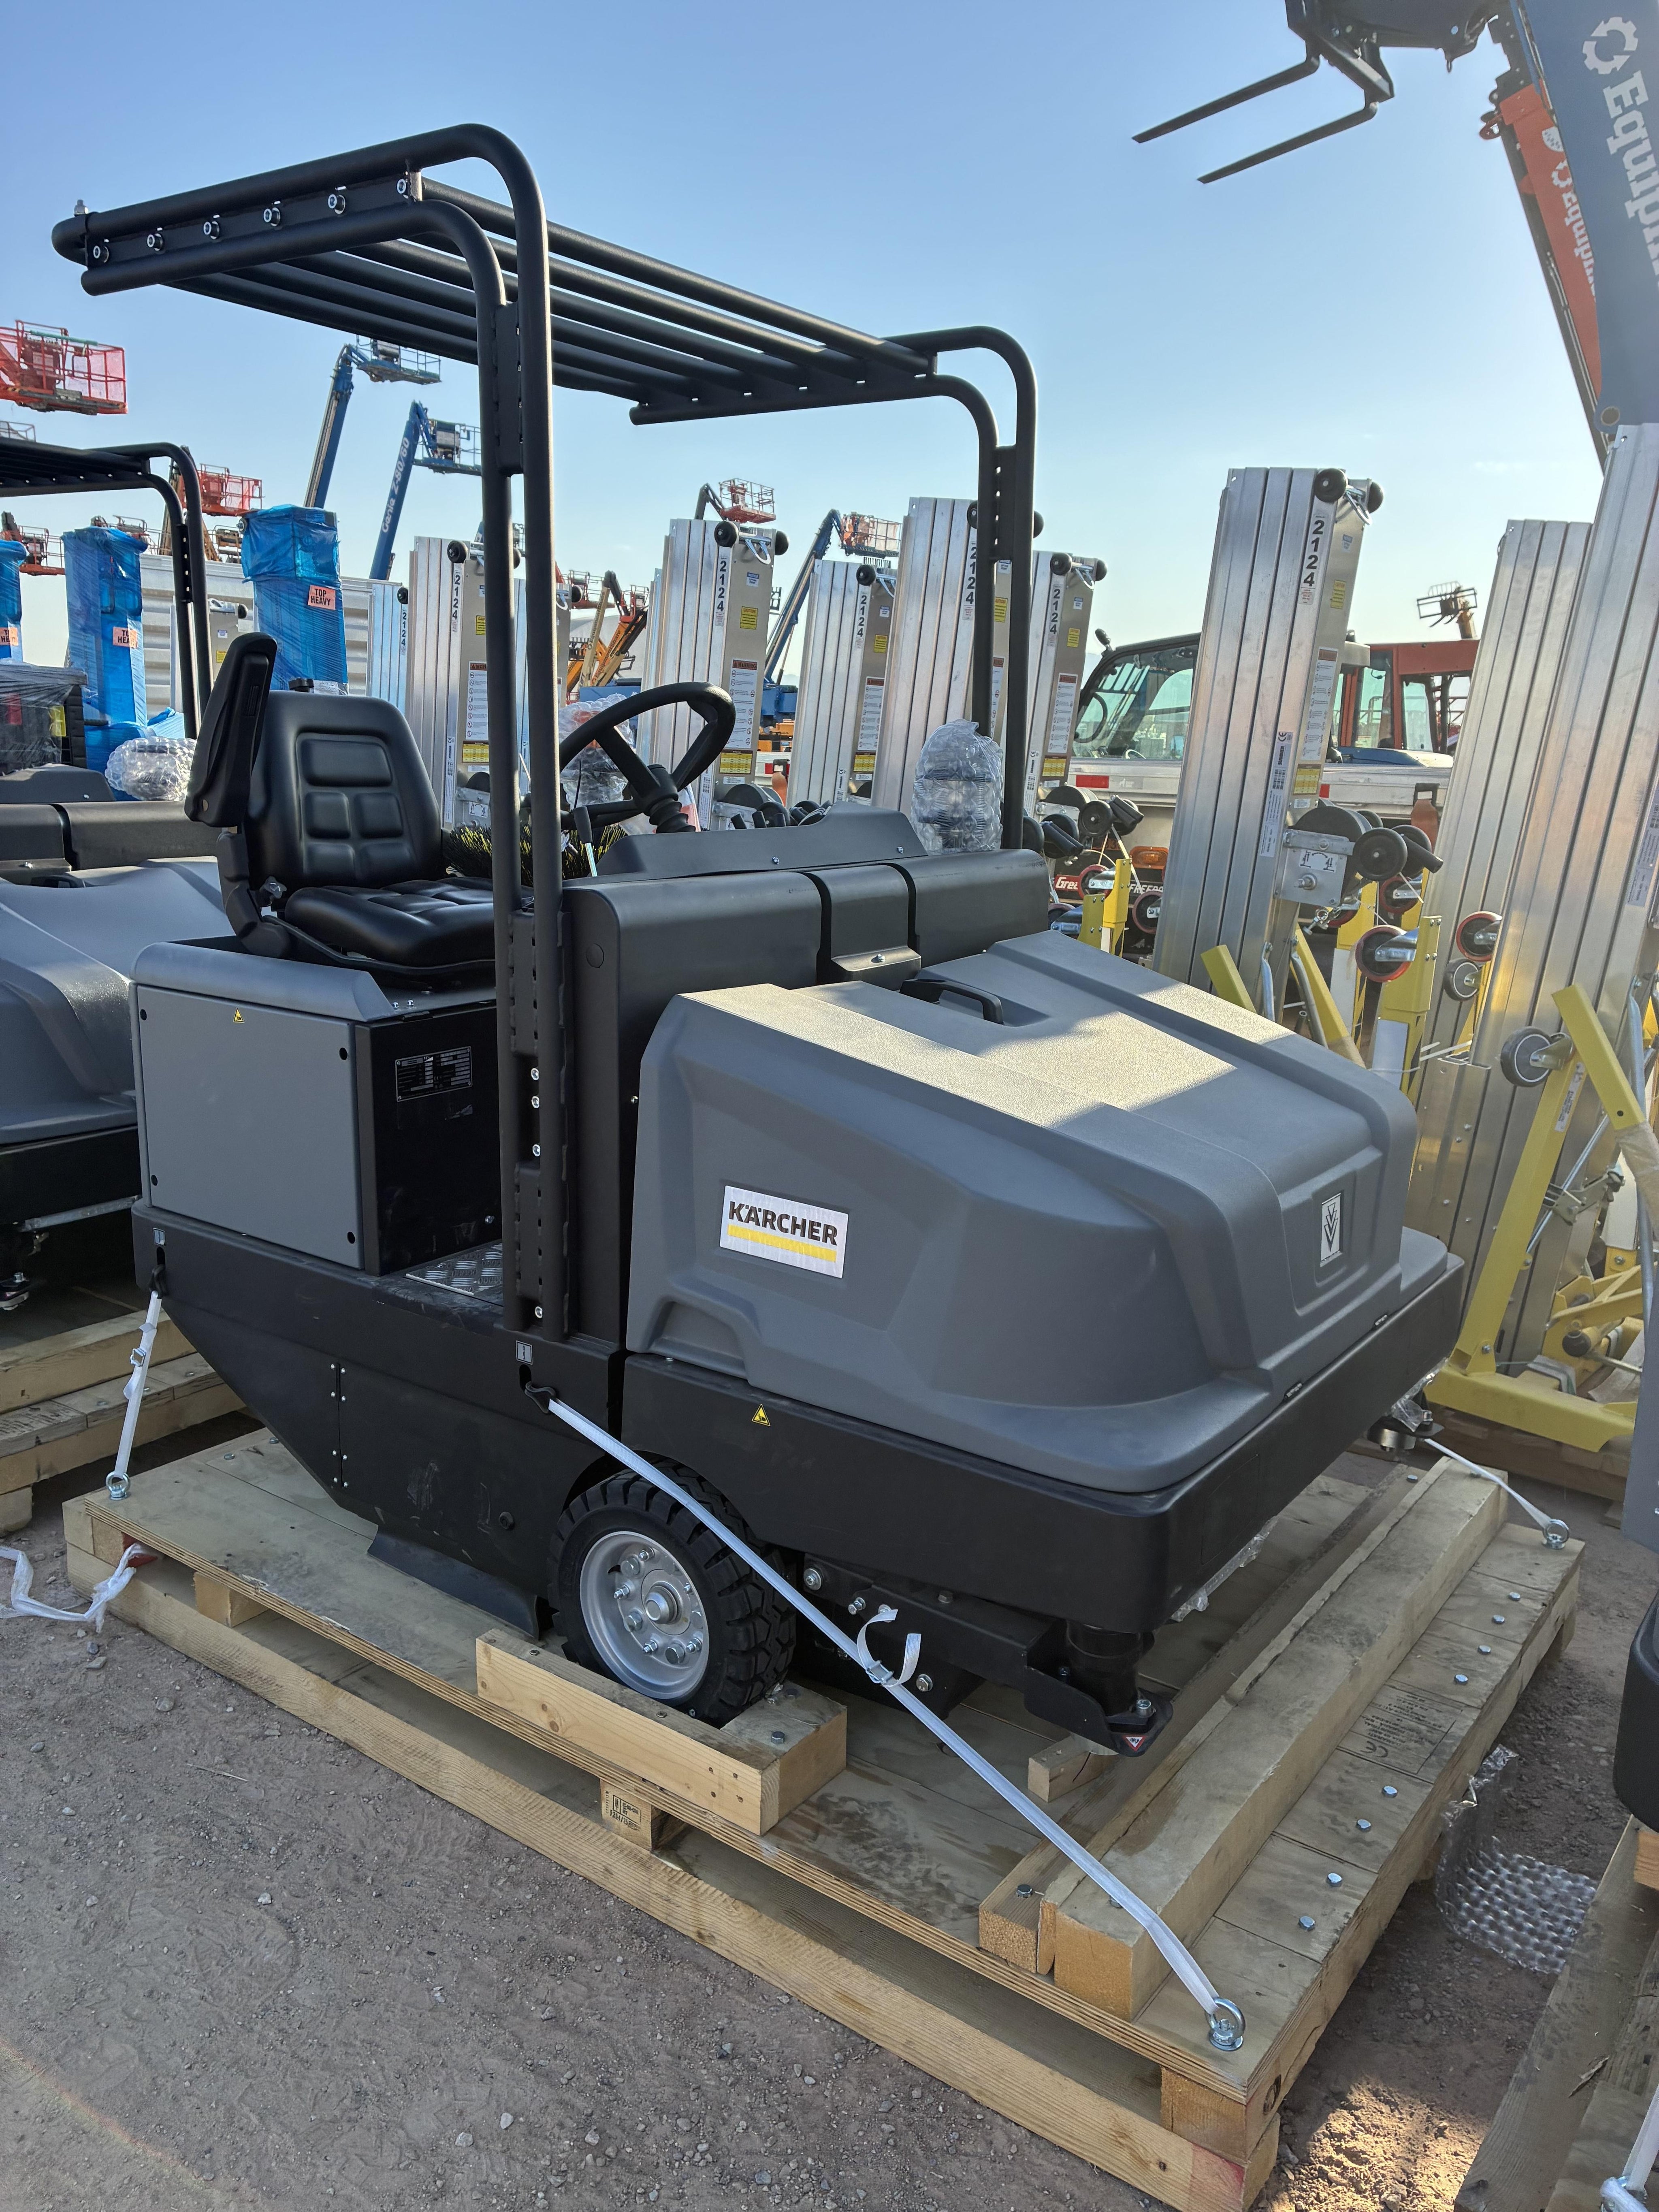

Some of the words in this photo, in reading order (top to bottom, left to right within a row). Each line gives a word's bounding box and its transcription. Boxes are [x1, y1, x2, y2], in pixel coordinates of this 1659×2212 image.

[1603, 70, 1659, 284] Equip
[382, 499, 396, 533] Genie
[392, 437, 409, 495] Z-80/60
[966, 547, 977, 604] 2124
[1303, 520, 1324, 587] 2124
[311, 596, 331, 606] HEAVY
[314, 589, 326, 597] TOP
[717, 560, 727, 612] 2124
[857, 595, 867, 637] 2124
[1050, 589, 1060, 634] 2124
[729, 1201, 838, 1246] KÄRCHER
